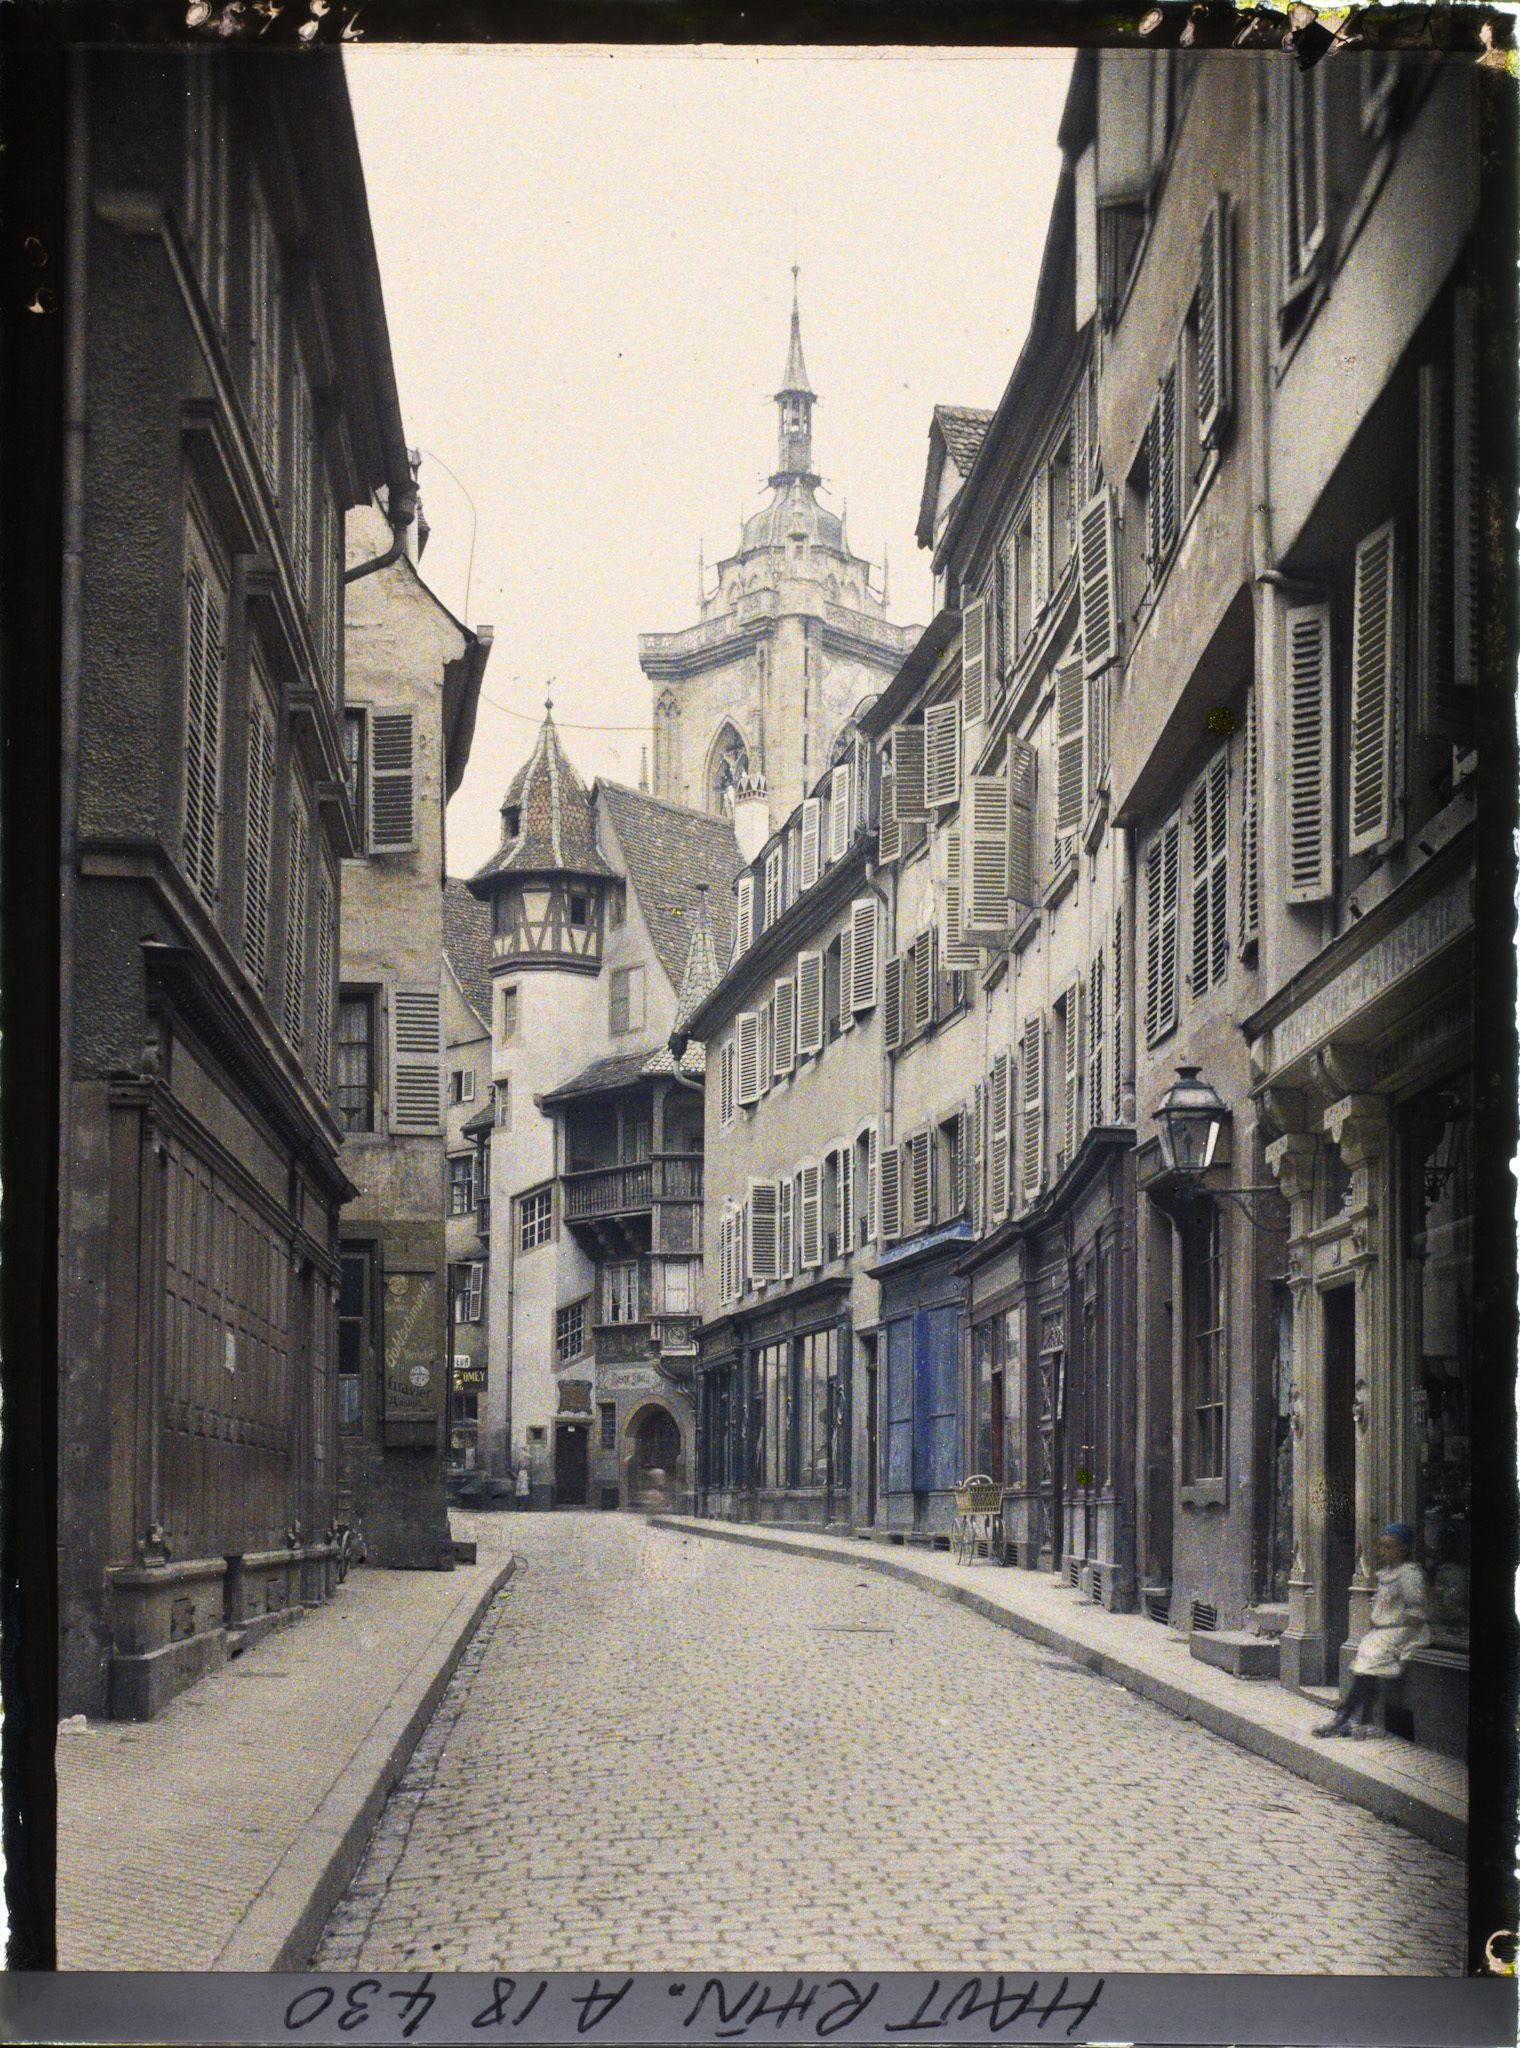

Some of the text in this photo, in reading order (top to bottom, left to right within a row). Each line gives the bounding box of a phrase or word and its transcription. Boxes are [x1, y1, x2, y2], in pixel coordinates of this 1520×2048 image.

[283, 1972, 438, 2038] 430
[471, 1976, 549, 2029] 18
[571, 1978, 635, 2034] A
[884, 1975, 1105, 2036] HAUT
